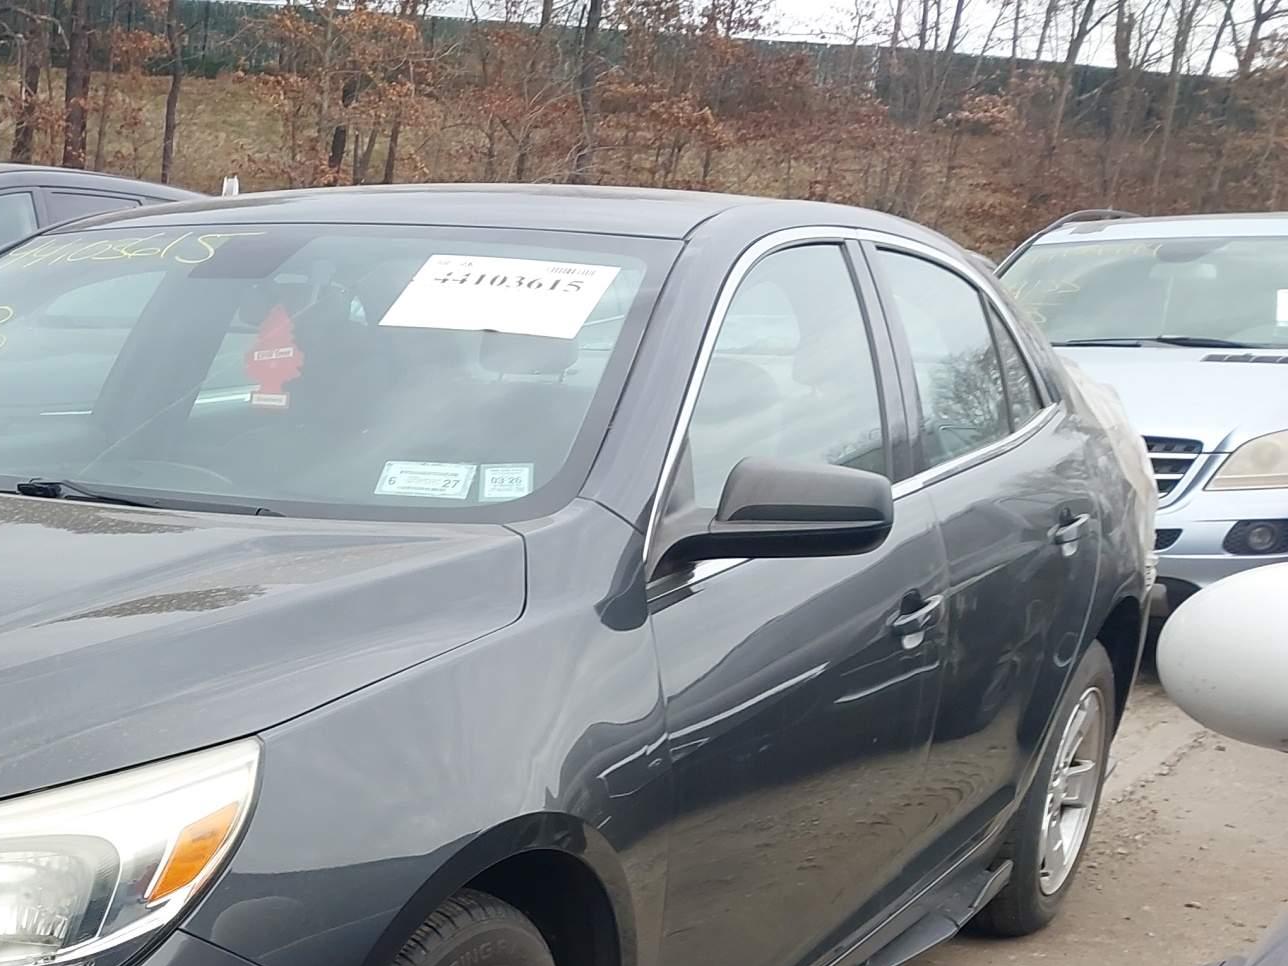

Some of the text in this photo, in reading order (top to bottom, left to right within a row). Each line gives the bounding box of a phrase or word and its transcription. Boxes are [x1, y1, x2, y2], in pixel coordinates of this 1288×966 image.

[434, 271, 585, 293] 44103615
[388, 476, 397, 486] 6
[441, 479, 461, 489] 27
